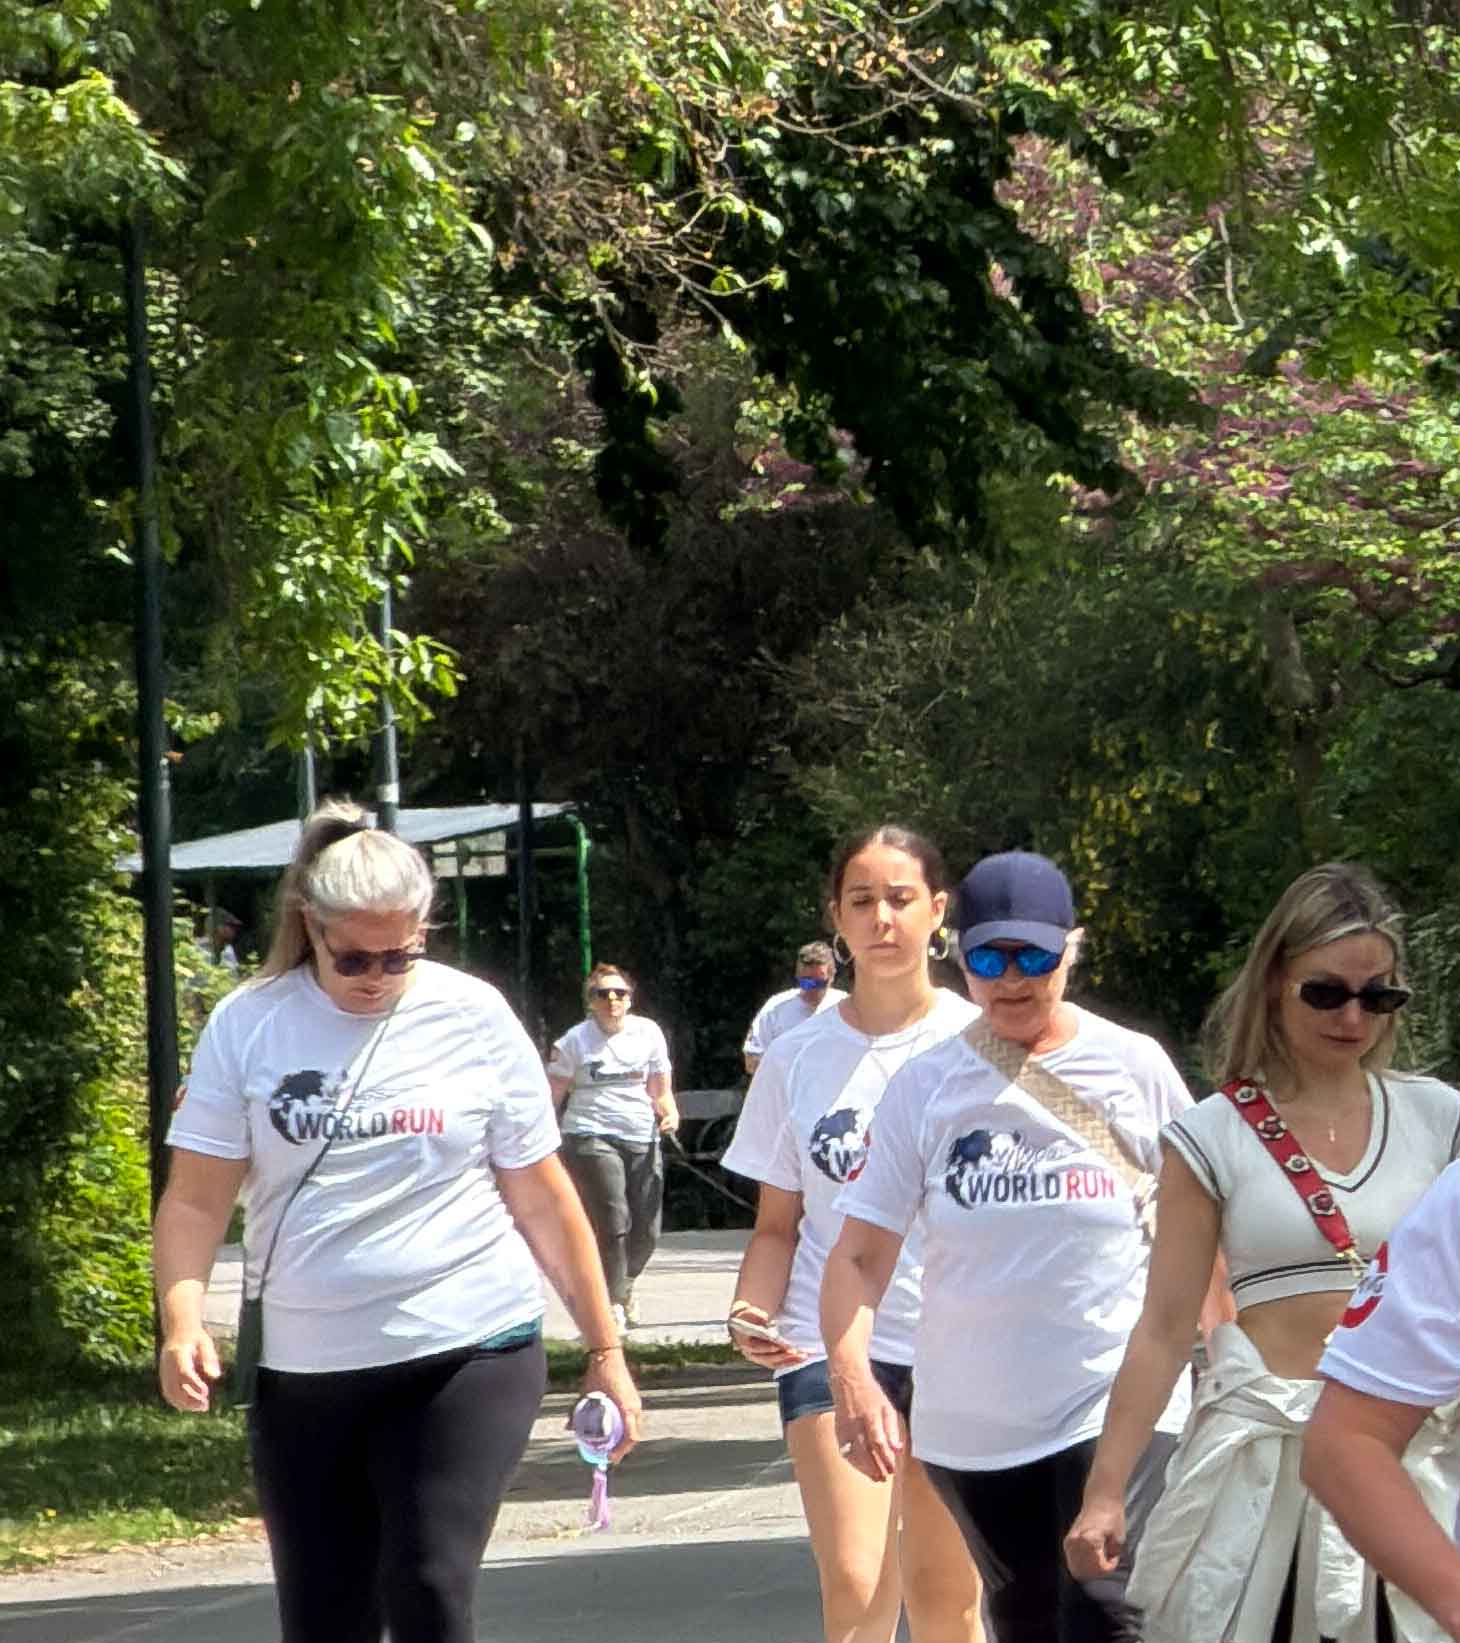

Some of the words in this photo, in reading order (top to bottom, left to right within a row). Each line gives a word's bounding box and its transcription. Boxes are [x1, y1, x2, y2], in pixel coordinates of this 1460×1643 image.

[295, 1111, 388, 1140] WORLD
[391, 1107, 444, 1134] RUN
[968, 1172, 1061, 1203] WORLD
[1066, 1168, 1115, 1201] RUN
